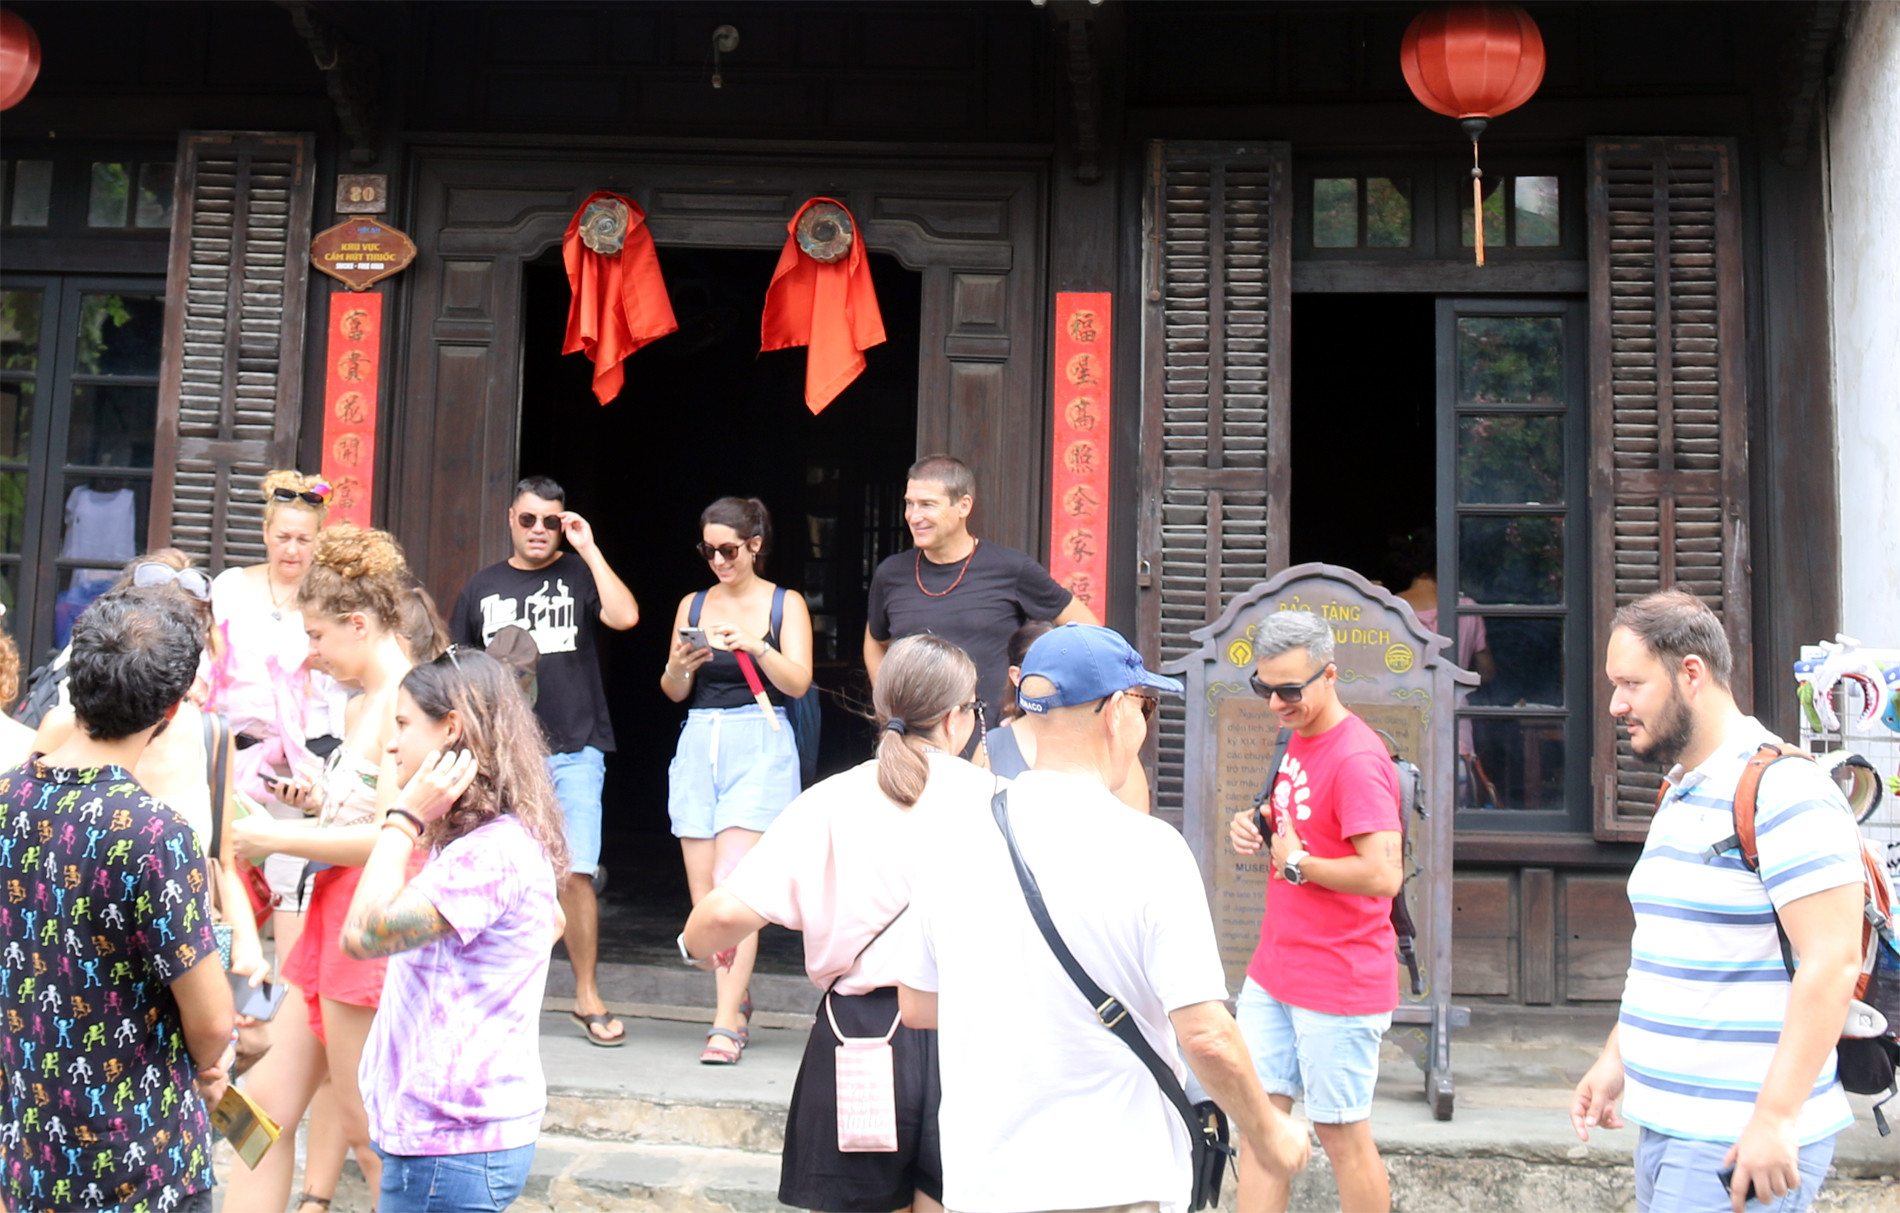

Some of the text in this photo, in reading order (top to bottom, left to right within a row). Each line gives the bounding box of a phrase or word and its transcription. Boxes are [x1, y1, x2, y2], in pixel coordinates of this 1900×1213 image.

[350, 186, 375, 202] 80
[342, 243, 360, 251] KHU
[1351, 628, 1390, 648] DỊCH
